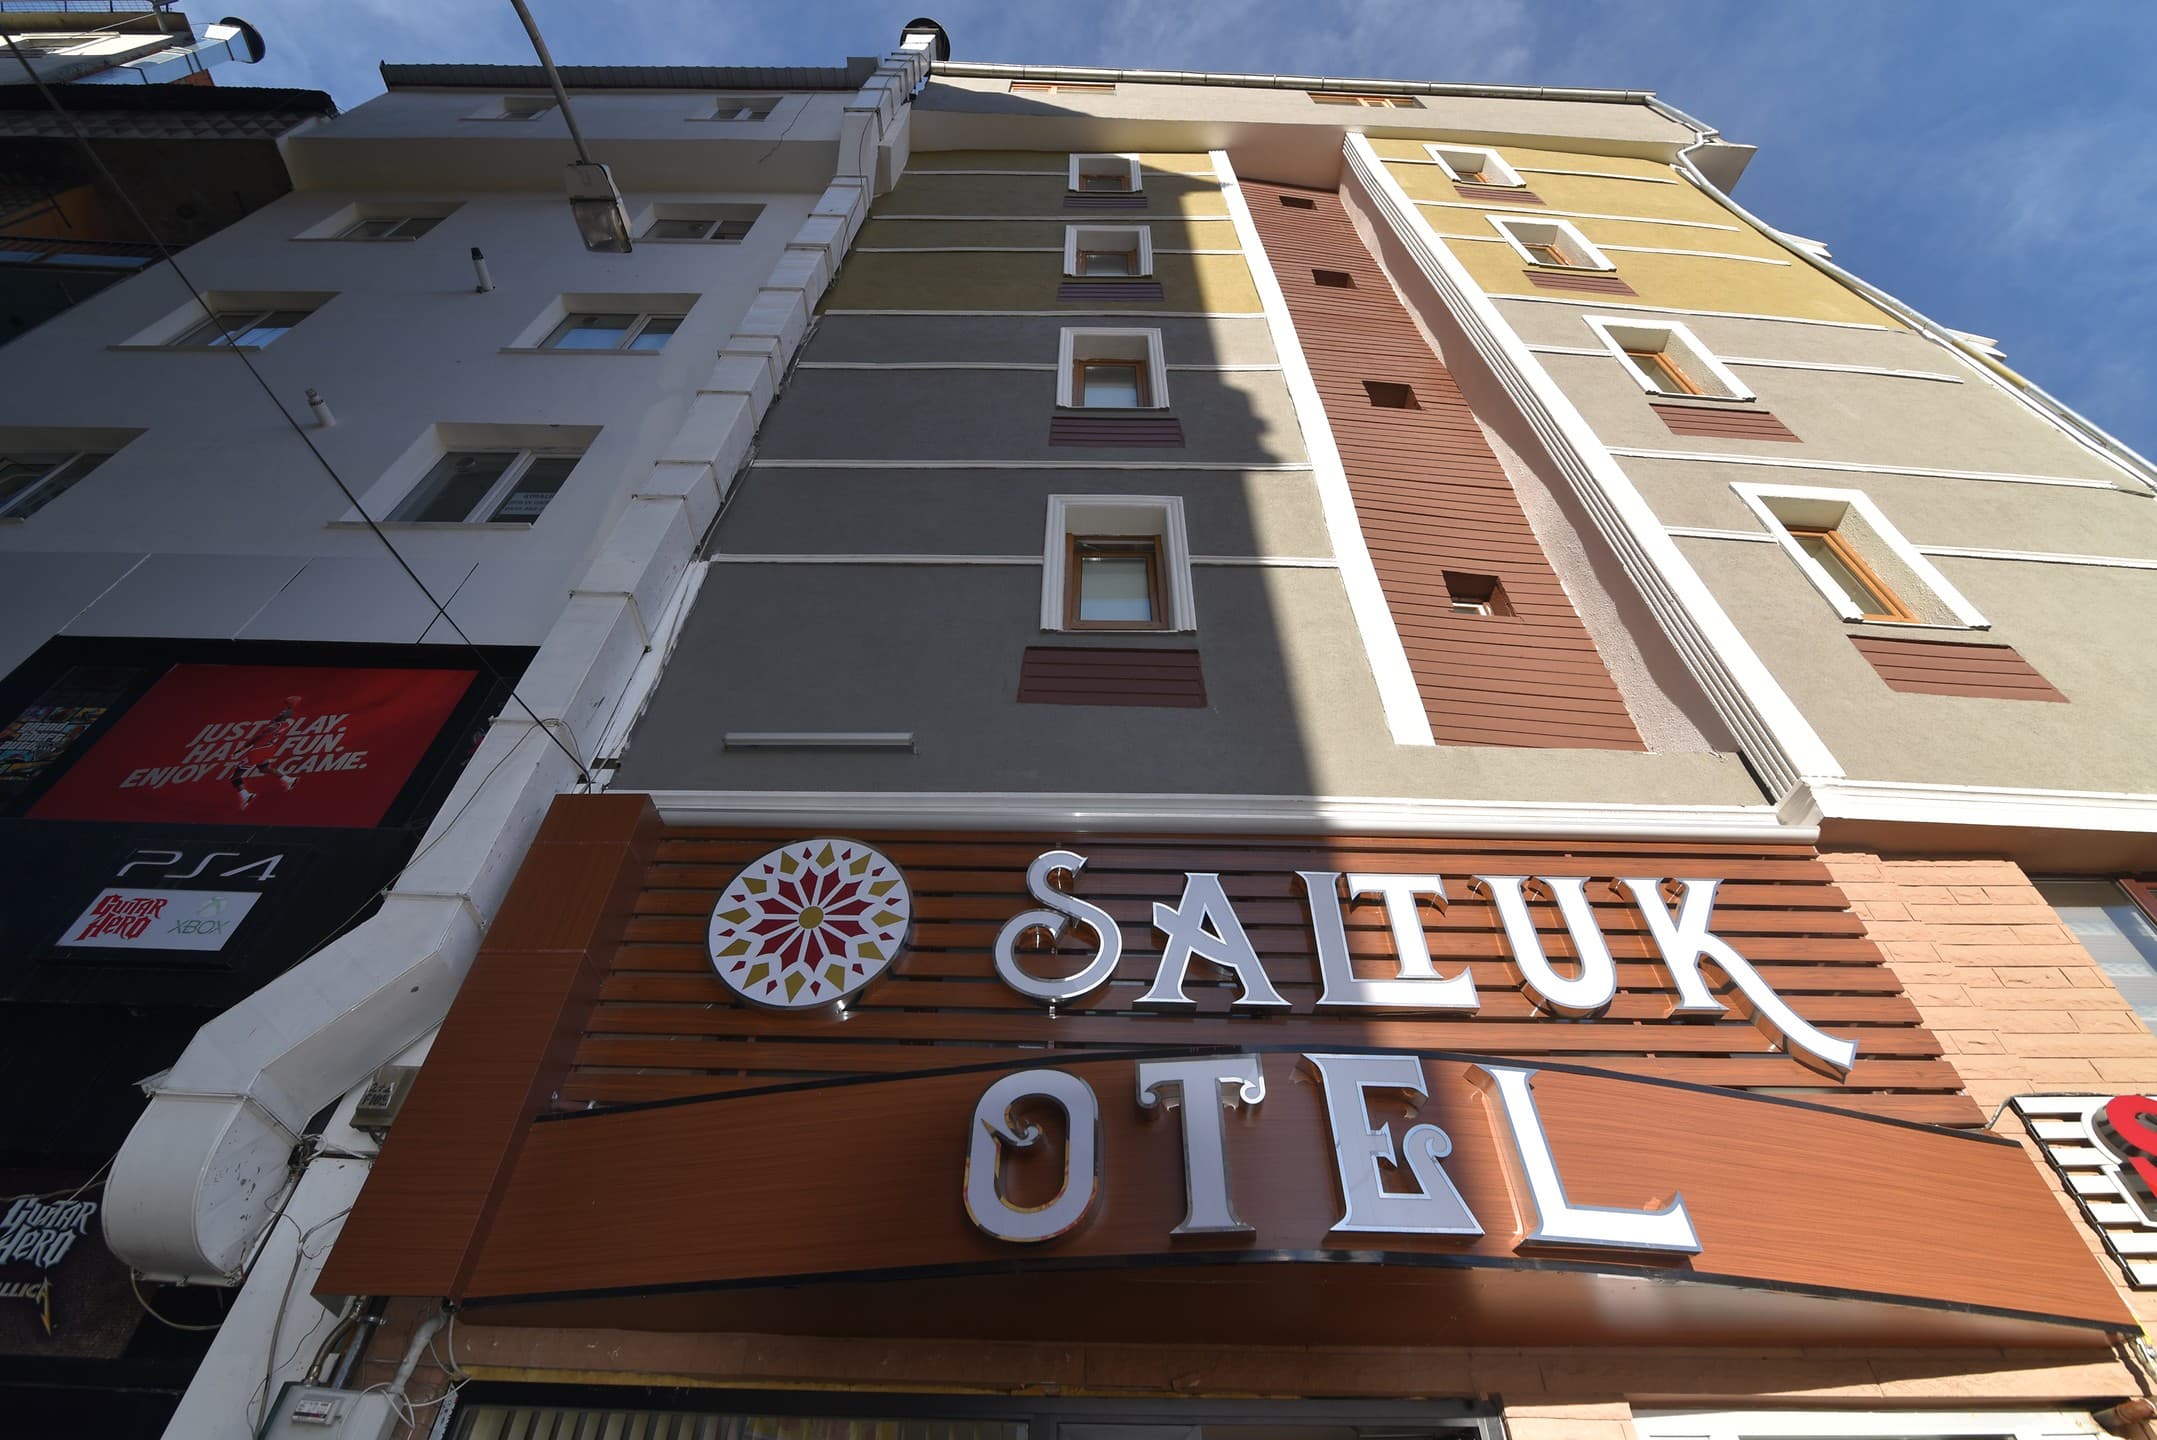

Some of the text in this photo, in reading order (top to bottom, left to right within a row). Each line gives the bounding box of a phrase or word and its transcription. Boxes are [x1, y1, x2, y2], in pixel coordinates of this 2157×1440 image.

[181, 733, 345, 766] HAV FUN.
[184, 719, 271, 748] JUST
[119, 762, 217, 789] ENJOY
[276, 750, 369, 775] GAME.
[115, 850, 284, 881] PS4
[167, 919, 231, 936] XBOX
[993, 849, 1859, 1074] SALTUK
[963, 1052, 1703, 1257] OTEL
